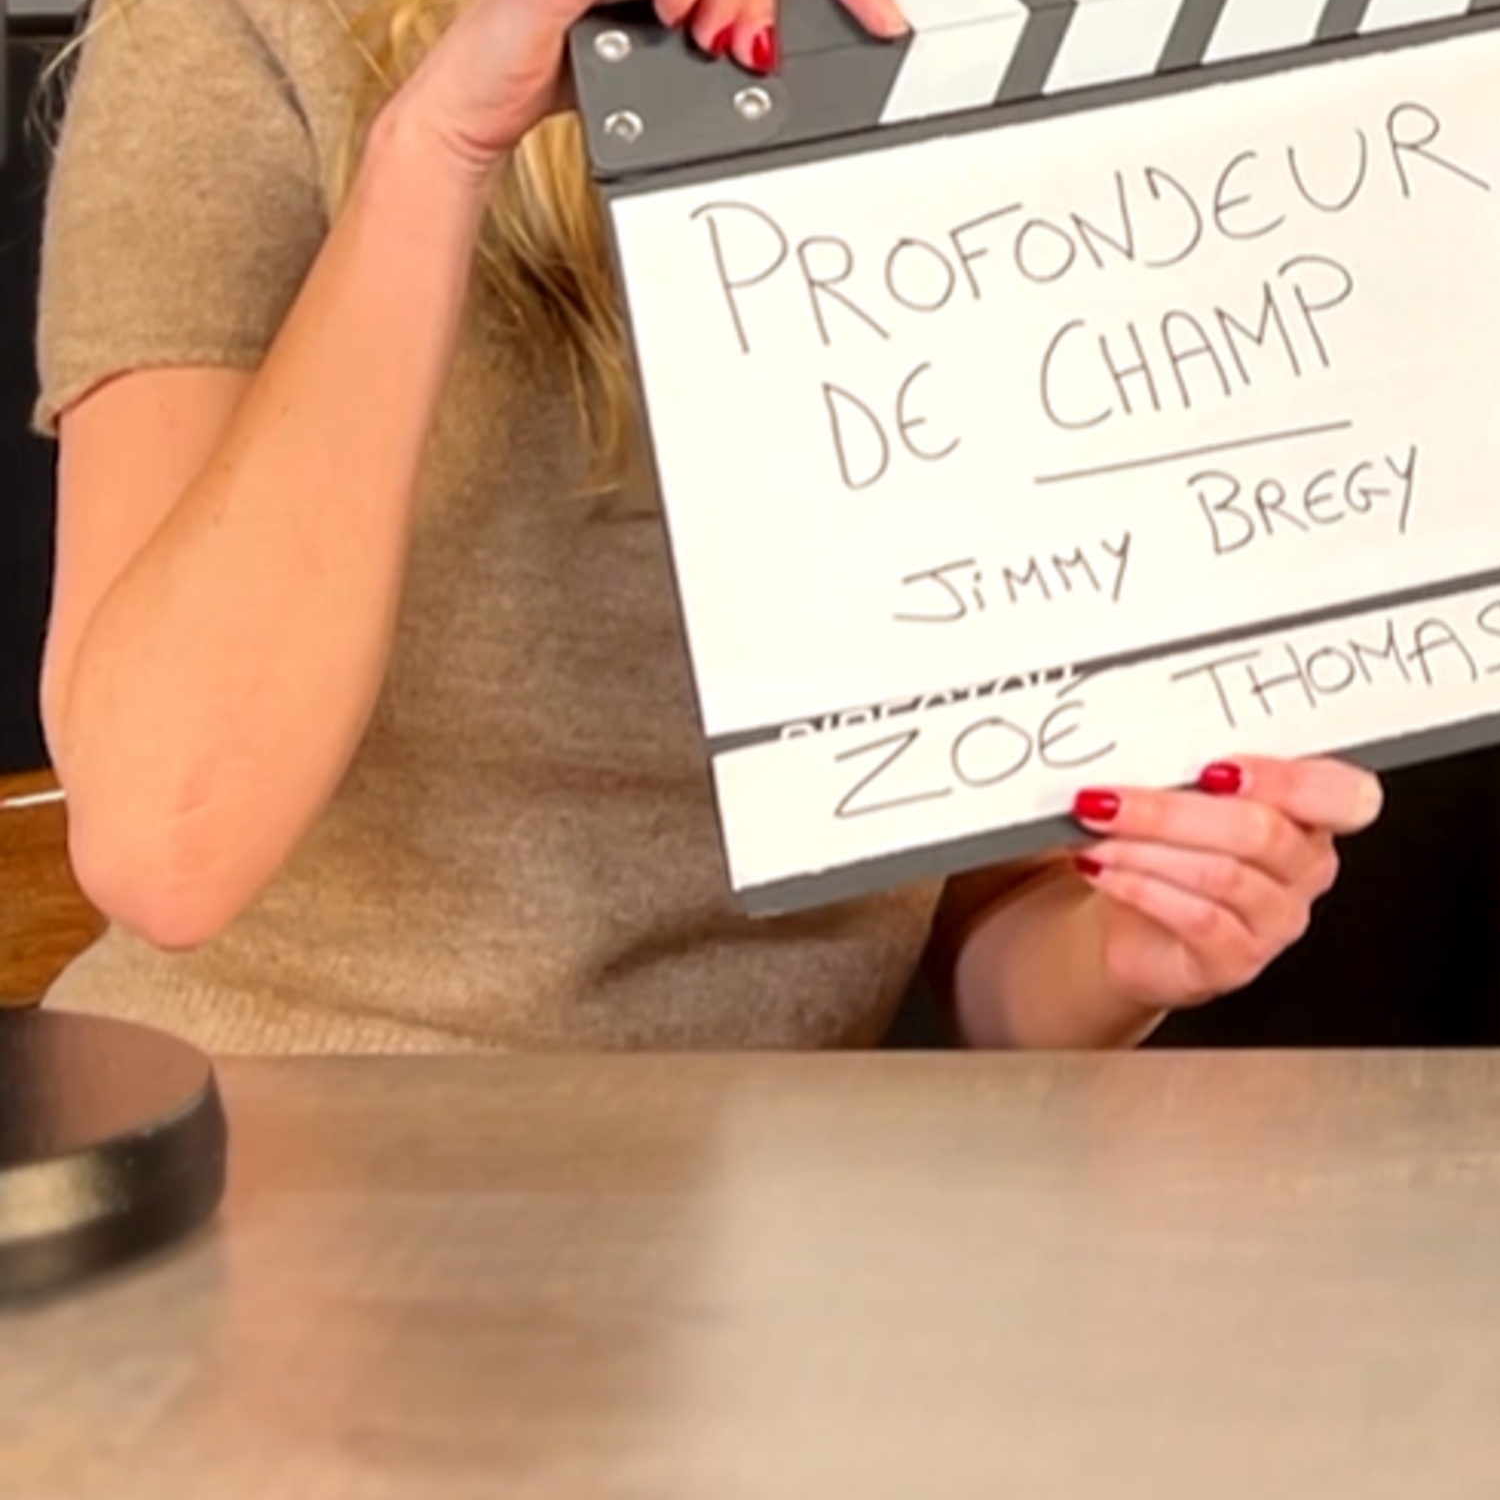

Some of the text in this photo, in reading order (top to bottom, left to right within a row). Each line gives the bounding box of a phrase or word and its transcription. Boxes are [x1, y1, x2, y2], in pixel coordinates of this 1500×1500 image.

[690, 102, 1490, 353] PROFONDEUR
[822, 255, 1354, 488] DE CHAMP
[1187, 445, 1417, 555] BREGY
[834, 670, 1117, 818] ZOÉ
